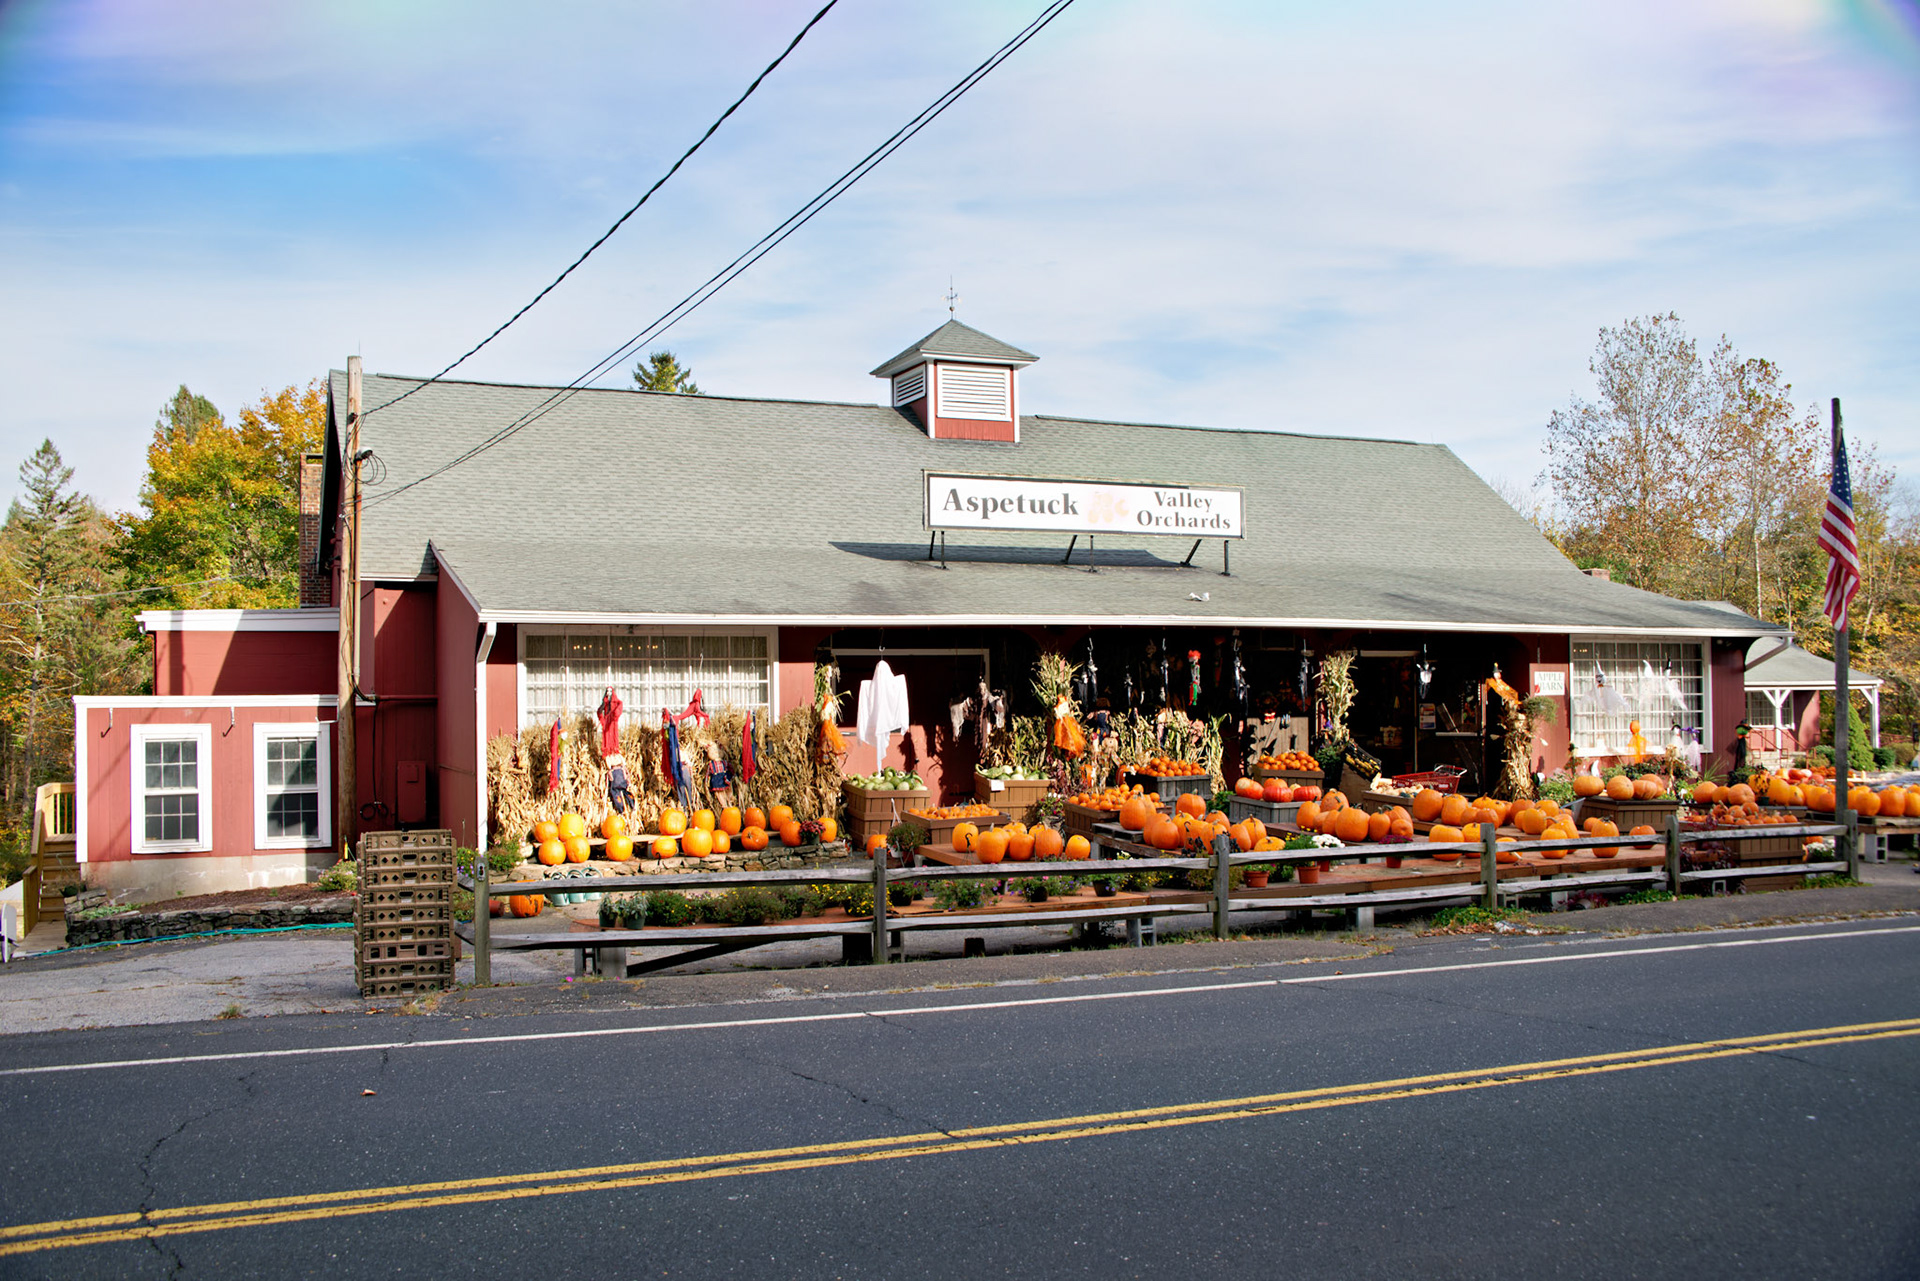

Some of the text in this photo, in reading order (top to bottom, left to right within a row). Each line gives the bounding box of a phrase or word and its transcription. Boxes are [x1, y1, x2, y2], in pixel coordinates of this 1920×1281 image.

[943, 488, 1079, 520] Aspetuck
[1154, 491, 1213, 513] Valley
[1136, 509, 1231, 530] Orchards
[1537, 672, 1563, 681] APPLE
